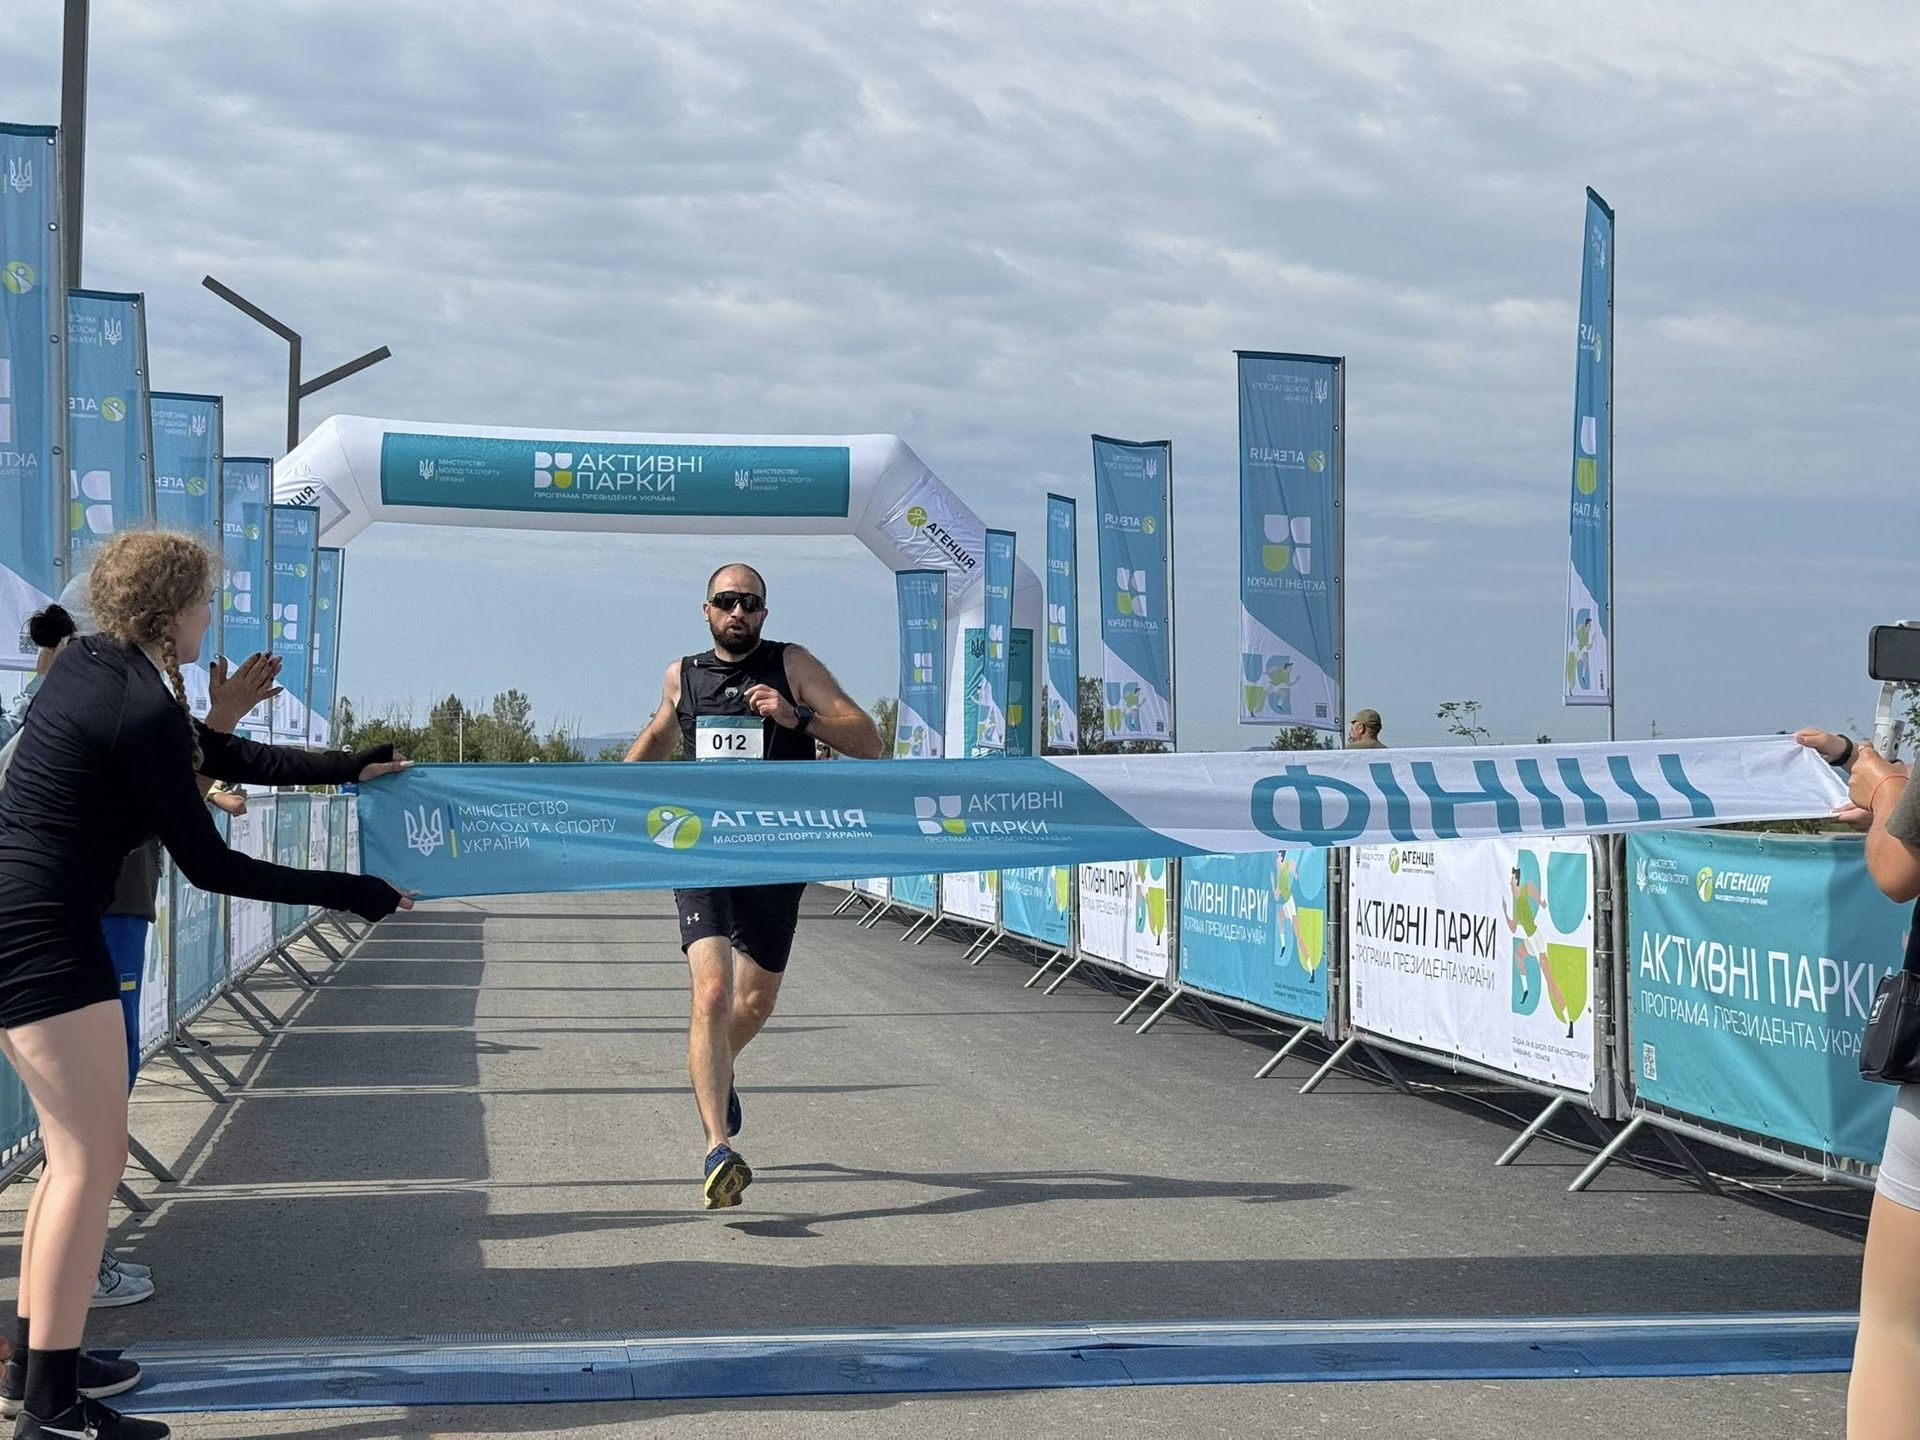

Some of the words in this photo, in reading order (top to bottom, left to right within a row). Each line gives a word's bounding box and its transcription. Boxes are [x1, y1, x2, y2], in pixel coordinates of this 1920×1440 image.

[577, 453, 703, 472] АКТИВНІ
[576, 471, 675, 492] ПАРКИ
[533, 491, 579, 500] ПРОГРАМА
[581, 493, 637, 502] ПРЕЗИДЕНТА
[639, 494, 676, 502] УКРАЇНИ
[926, 522, 976, 569] АГЕНЦІЯ
[712, 733, 747, 751] 012
[458, 800, 569, 818] МІНІСТЕРСТВО
[967, 790, 1063, 813] АКТИВНІ
[1251, 753, 1716, 847] ФІНІШ
[461, 820, 528, 833] МОЛОДІ
[532, 822, 552, 833] ТА
[555, 818, 617, 834] СПОРТУ
[711, 808, 868, 829] АГЕНЦІЯ
[972, 819, 1048, 834] ПАРКИ
[463, 834, 531, 853] УКРАЇНИ
[713, 834, 775, 844] МАСОВОГО
[778, 832, 822, 841] СПОРТУ
[824, 831, 873, 839] УКРАЇНИ
[1401, 850, 1435, 868] АГЕНЦІЯ
[1714, 871, 1772, 895] АГЕНЦІЯ
[1355, 897, 1428, 947] АКТИВНІ
[1434, 908, 1497, 961] ПАРКИ
[1355, 943, 1391, 969] ПРОГРАМА
[1393, 951, 1457, 982] ПРЕЗИДЕНТА
[1458, 963, 1495, 991] УКРАЇНИ
[1640, 930, 1759, 1002] АКТИВНІ
[1640, 990, 1710, 1028] ПРОГРАМА
[1713, 1005, 1817, 1048] ПРЕЗИДЕНТА
[1817, 1025, 1866, 1058] УКРА
